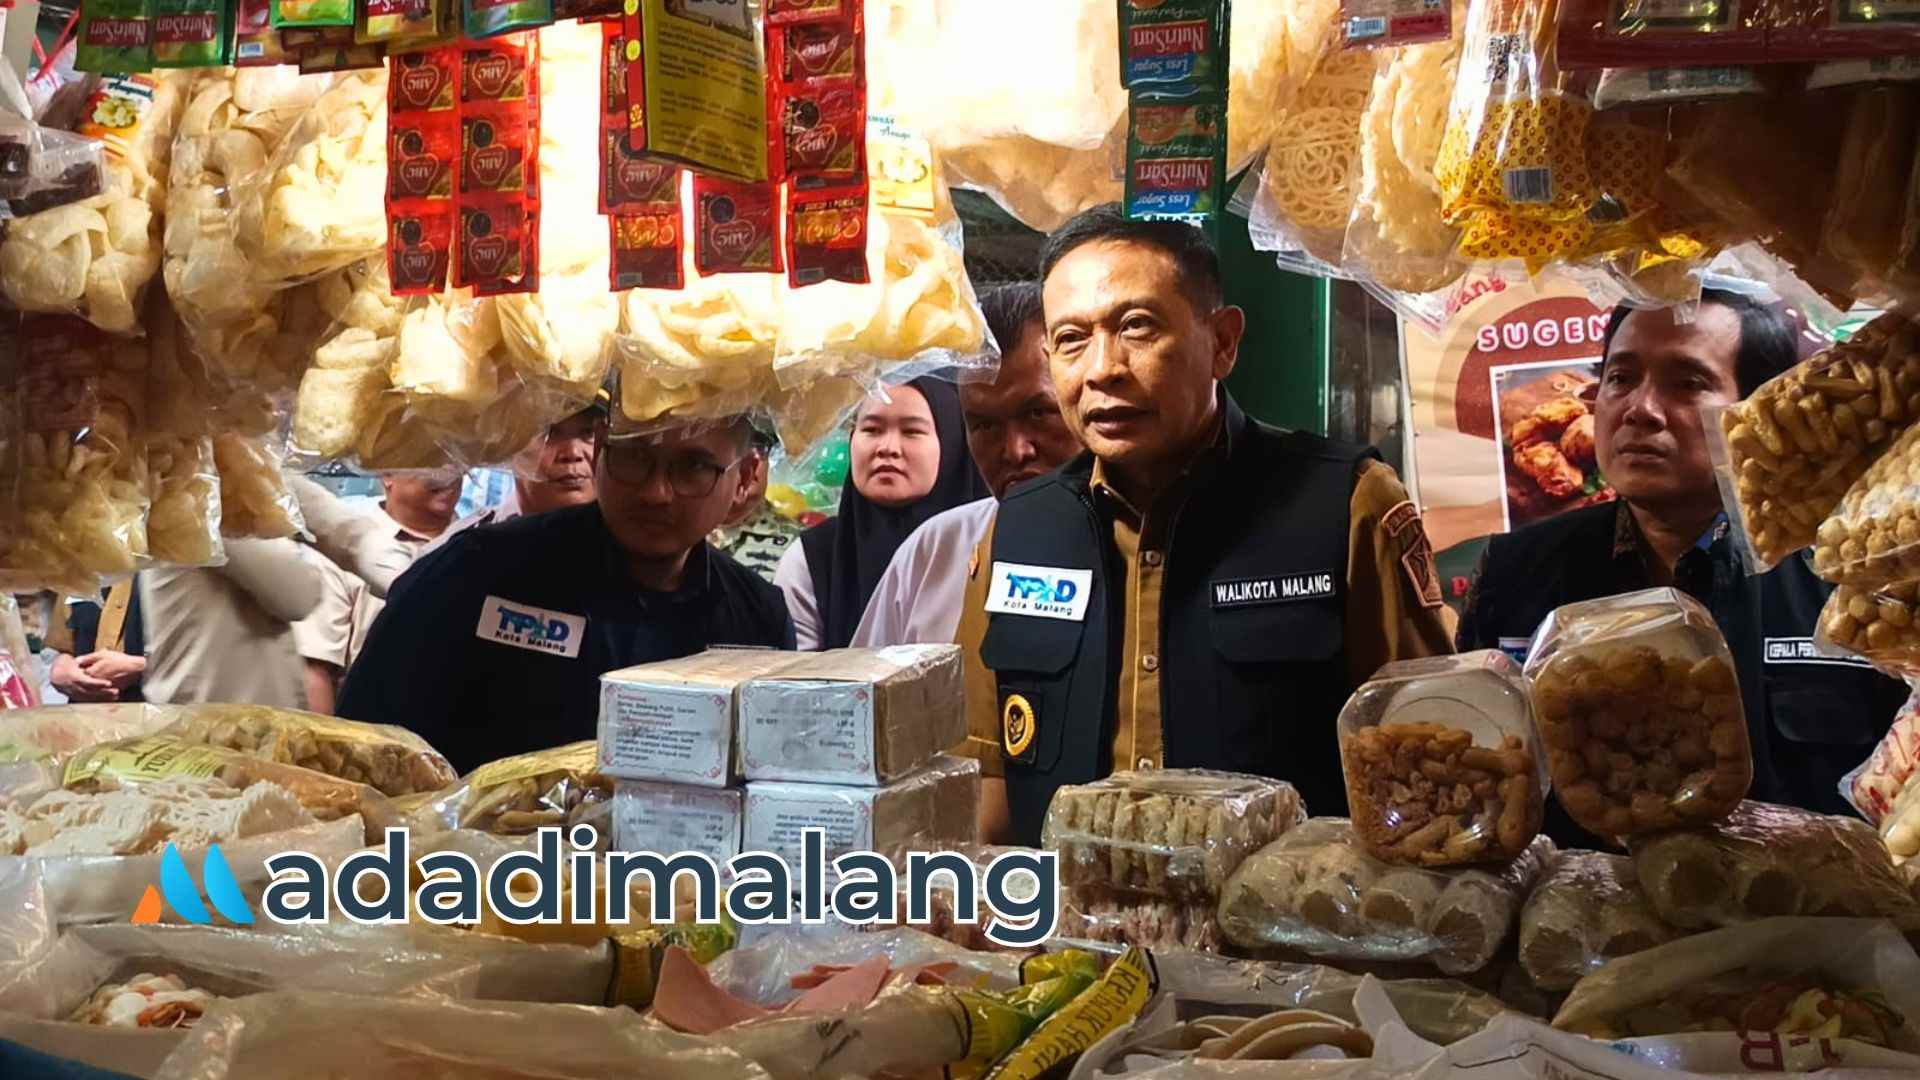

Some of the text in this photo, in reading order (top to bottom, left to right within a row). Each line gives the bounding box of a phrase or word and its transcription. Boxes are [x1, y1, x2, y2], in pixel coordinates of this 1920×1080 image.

[90, 21, 147, 44] NutriSari
[1133, 26, 1204, 53] NutriSari
[478, 65, 505, 80] ABC
[1135, 57, 1188, 74] Less Sugar
[408, 77, 433, 91] ABC
[477, 157, 504, 171] ABC
[406, 166, 433, 179] ABC
[1140, 162, 1209, 188] NutriSari
[1136, 193, 1191, 209] Less Sugar
[406, 255, 431, 269] ABC
[473, 247, 500, 261] ABC
[1216, 574, 1331, 603] WALIKOTA MALANG
[1003, 600, 1073, 617] Kota Malang
[494, 630, 567, 653] Kota Malang
